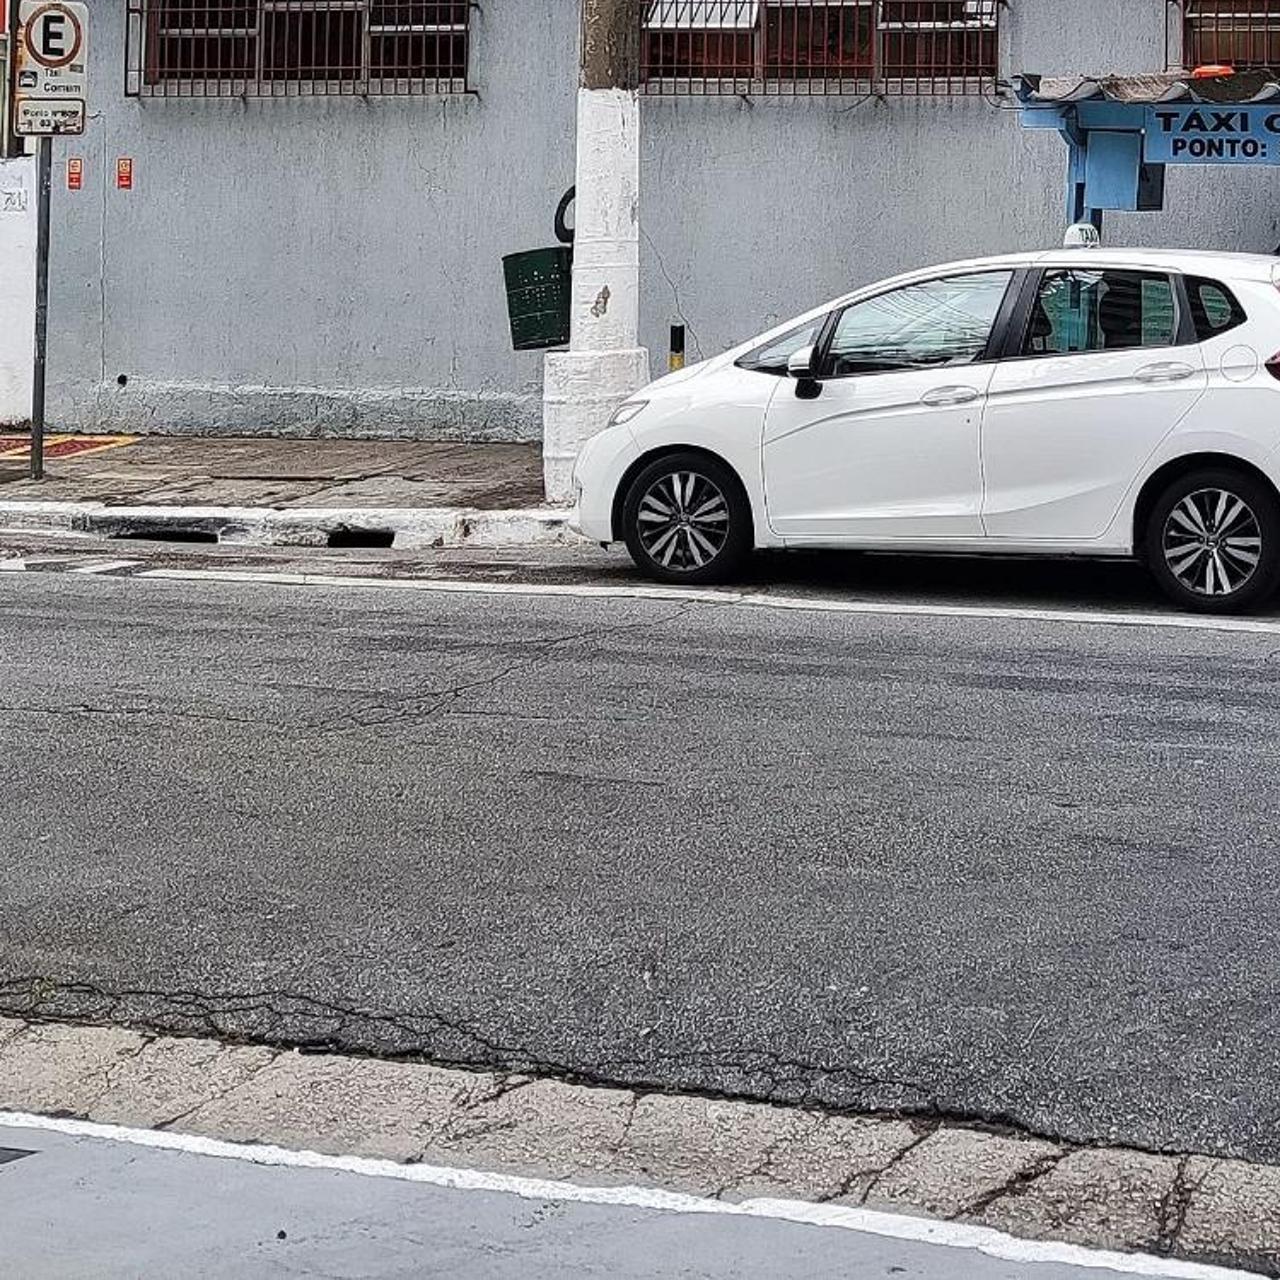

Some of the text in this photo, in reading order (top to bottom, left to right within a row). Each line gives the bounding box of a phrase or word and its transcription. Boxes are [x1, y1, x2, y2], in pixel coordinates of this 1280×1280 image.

[42, 15, 65, 56] E
[1172, 138, 1267, 157] PONTO:
[1079, 228, 1098, 243] TAXI
